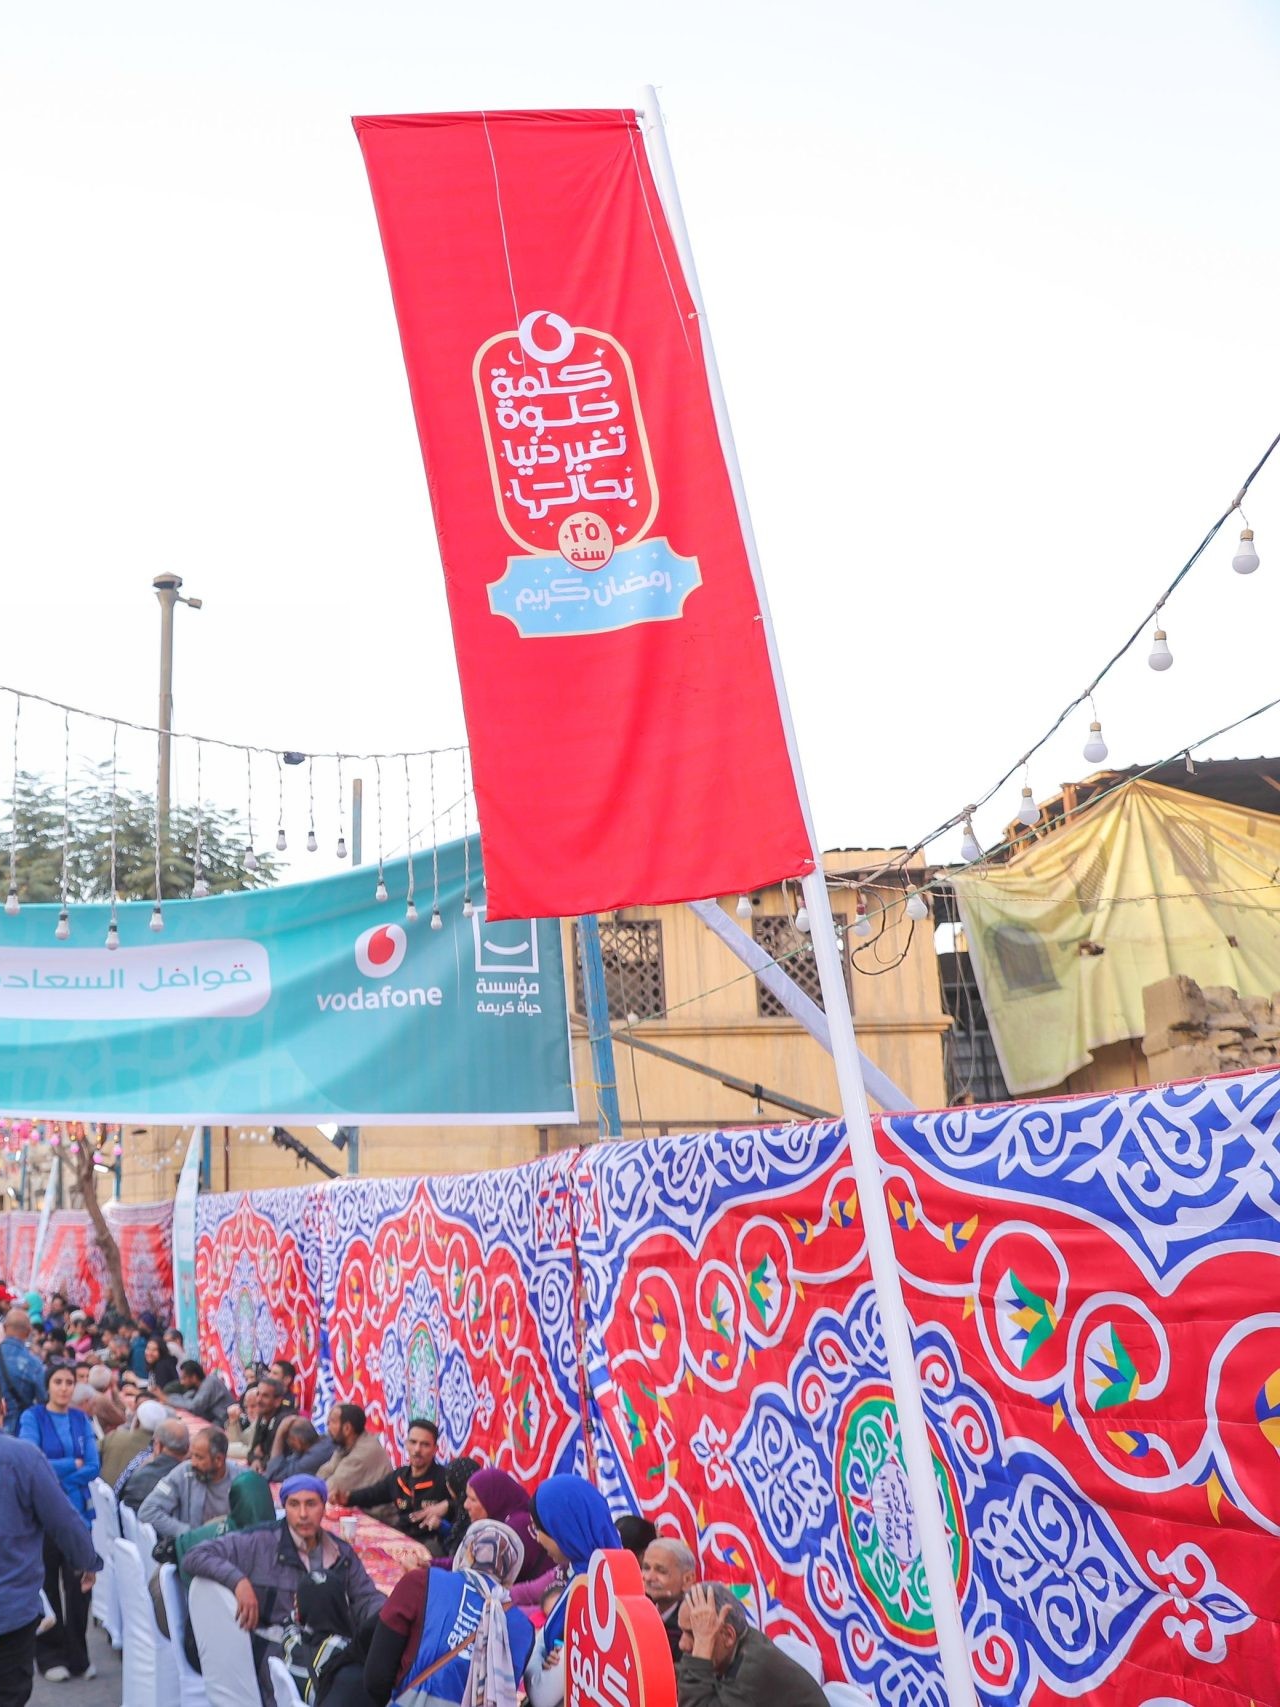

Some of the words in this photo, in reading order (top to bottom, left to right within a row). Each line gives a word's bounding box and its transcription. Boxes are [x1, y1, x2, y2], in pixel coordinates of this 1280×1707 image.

[490, 361, 613, 399] كلمة
[495, 395, 620, 436] حلوة
[502, 436, 561, 475] دنيا
[563, 425, 627, 473] تغير
[509, 473, 637, 520] بحالها
[569, 523, 600, 543] ٢٥
[570, 547, 606, 562] سنة
[515, 577, 592, 611] كريم
[593, 570, 673, 607] رمضان
[138, 963, 253, 992] قوافل
[476, 977, 539, 999] مؤسسة
[316, 985, 443, 1012] vodafone
[477, 1000, 515, 1016] كريمة
[517, 1000, 542, 1016] حياة
